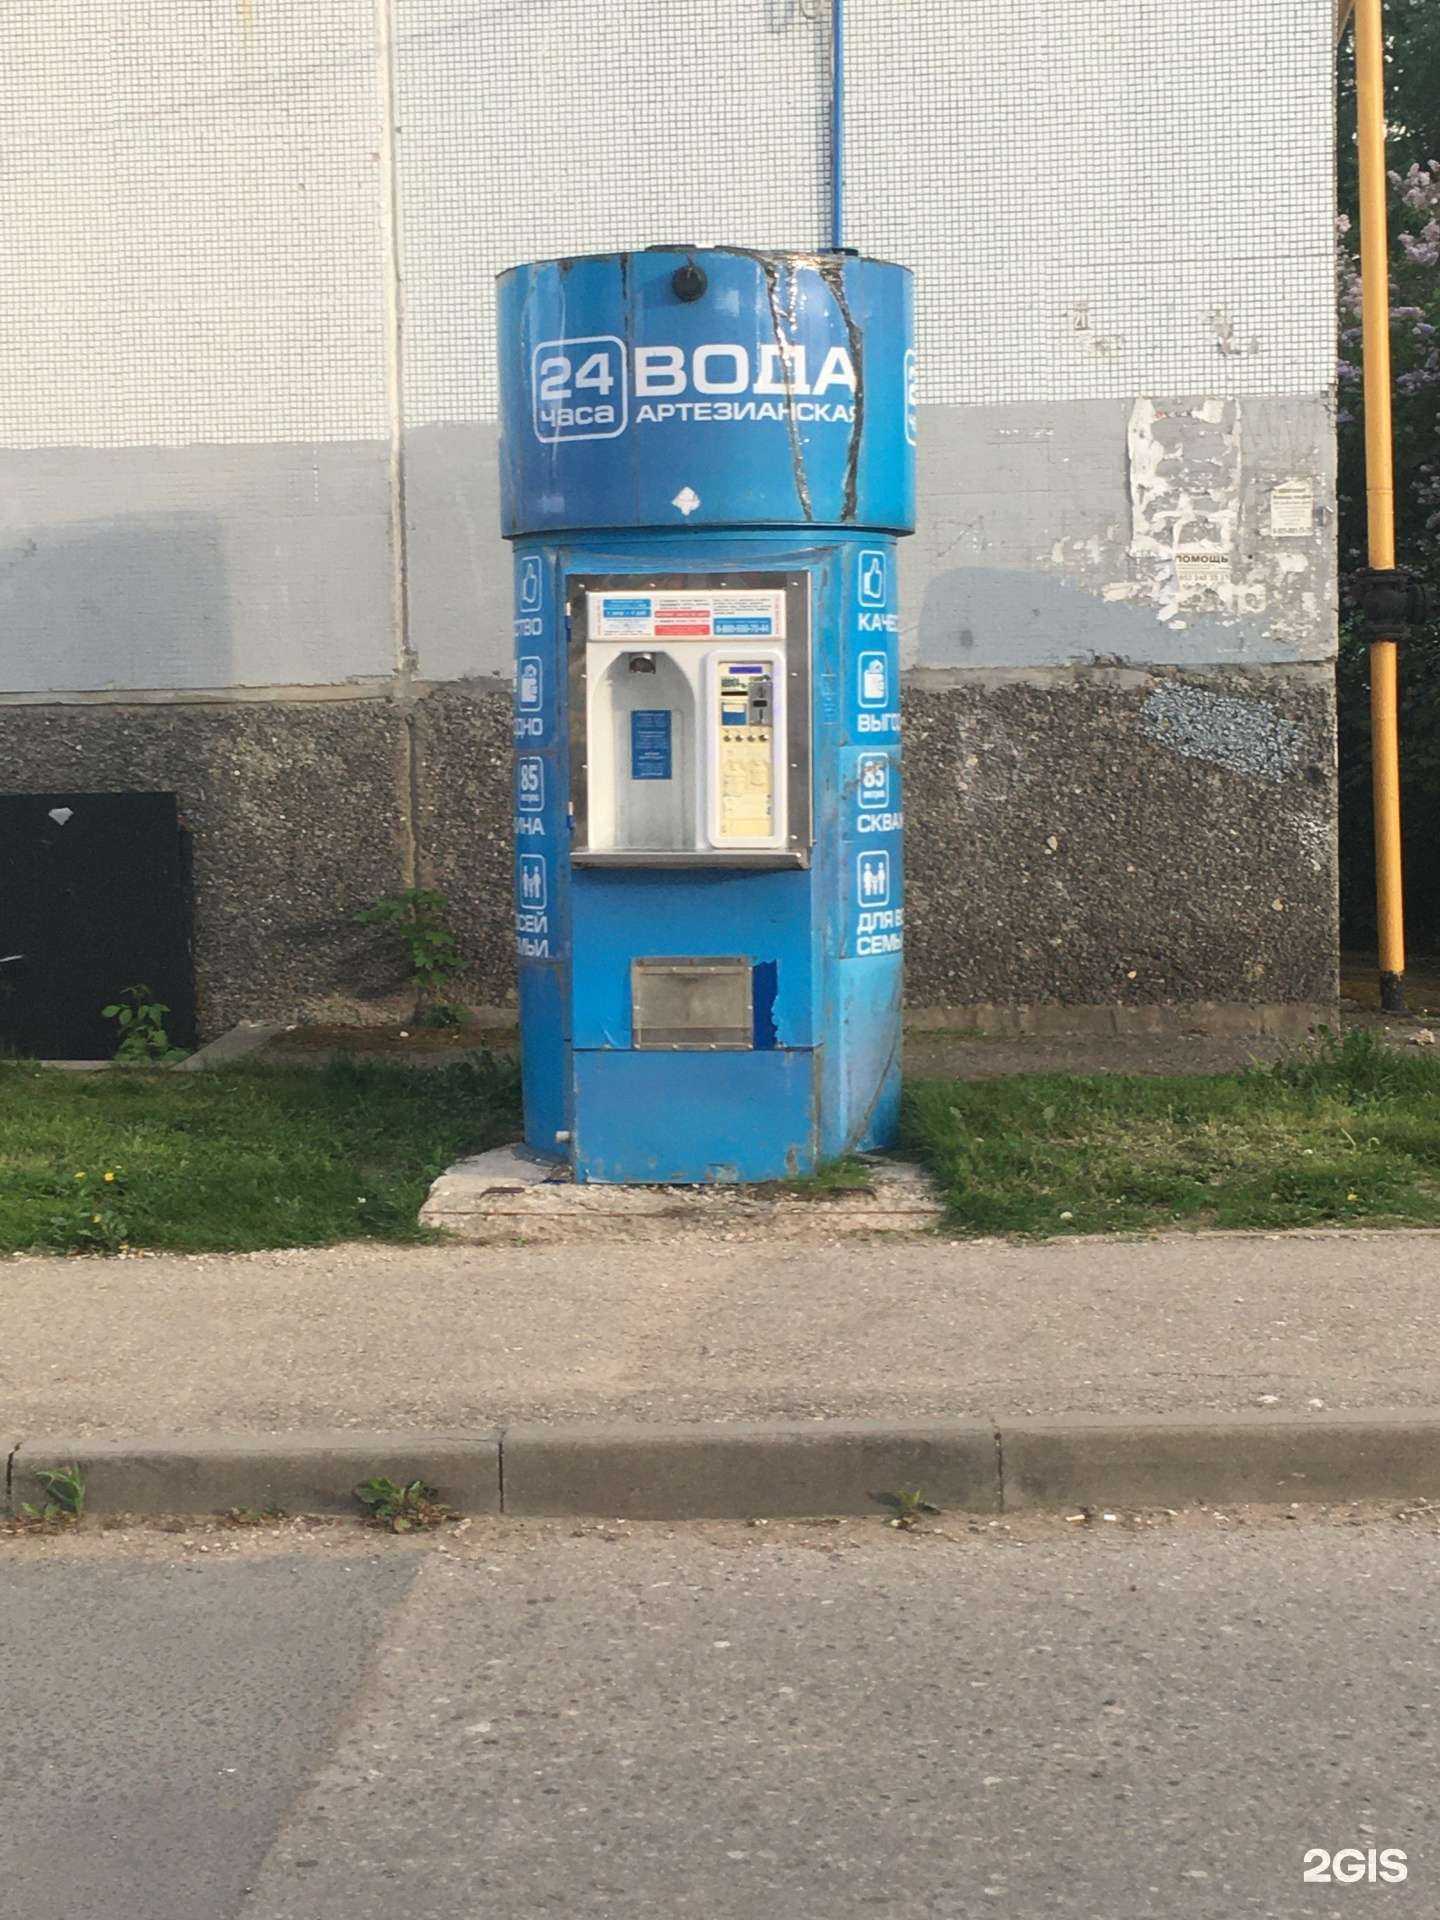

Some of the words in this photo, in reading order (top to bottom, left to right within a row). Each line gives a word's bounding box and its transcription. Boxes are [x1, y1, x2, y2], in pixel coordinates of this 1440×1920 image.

[541, 353, 614, 400] 24
[635, 344, 857, 397] ВОДА
[541, 404, 614, 427] часа
[858, 613, 901, 632] КАЧЕ
[521, 764, 539, 791] 85
[857, 813, 903, 832] СКВА
